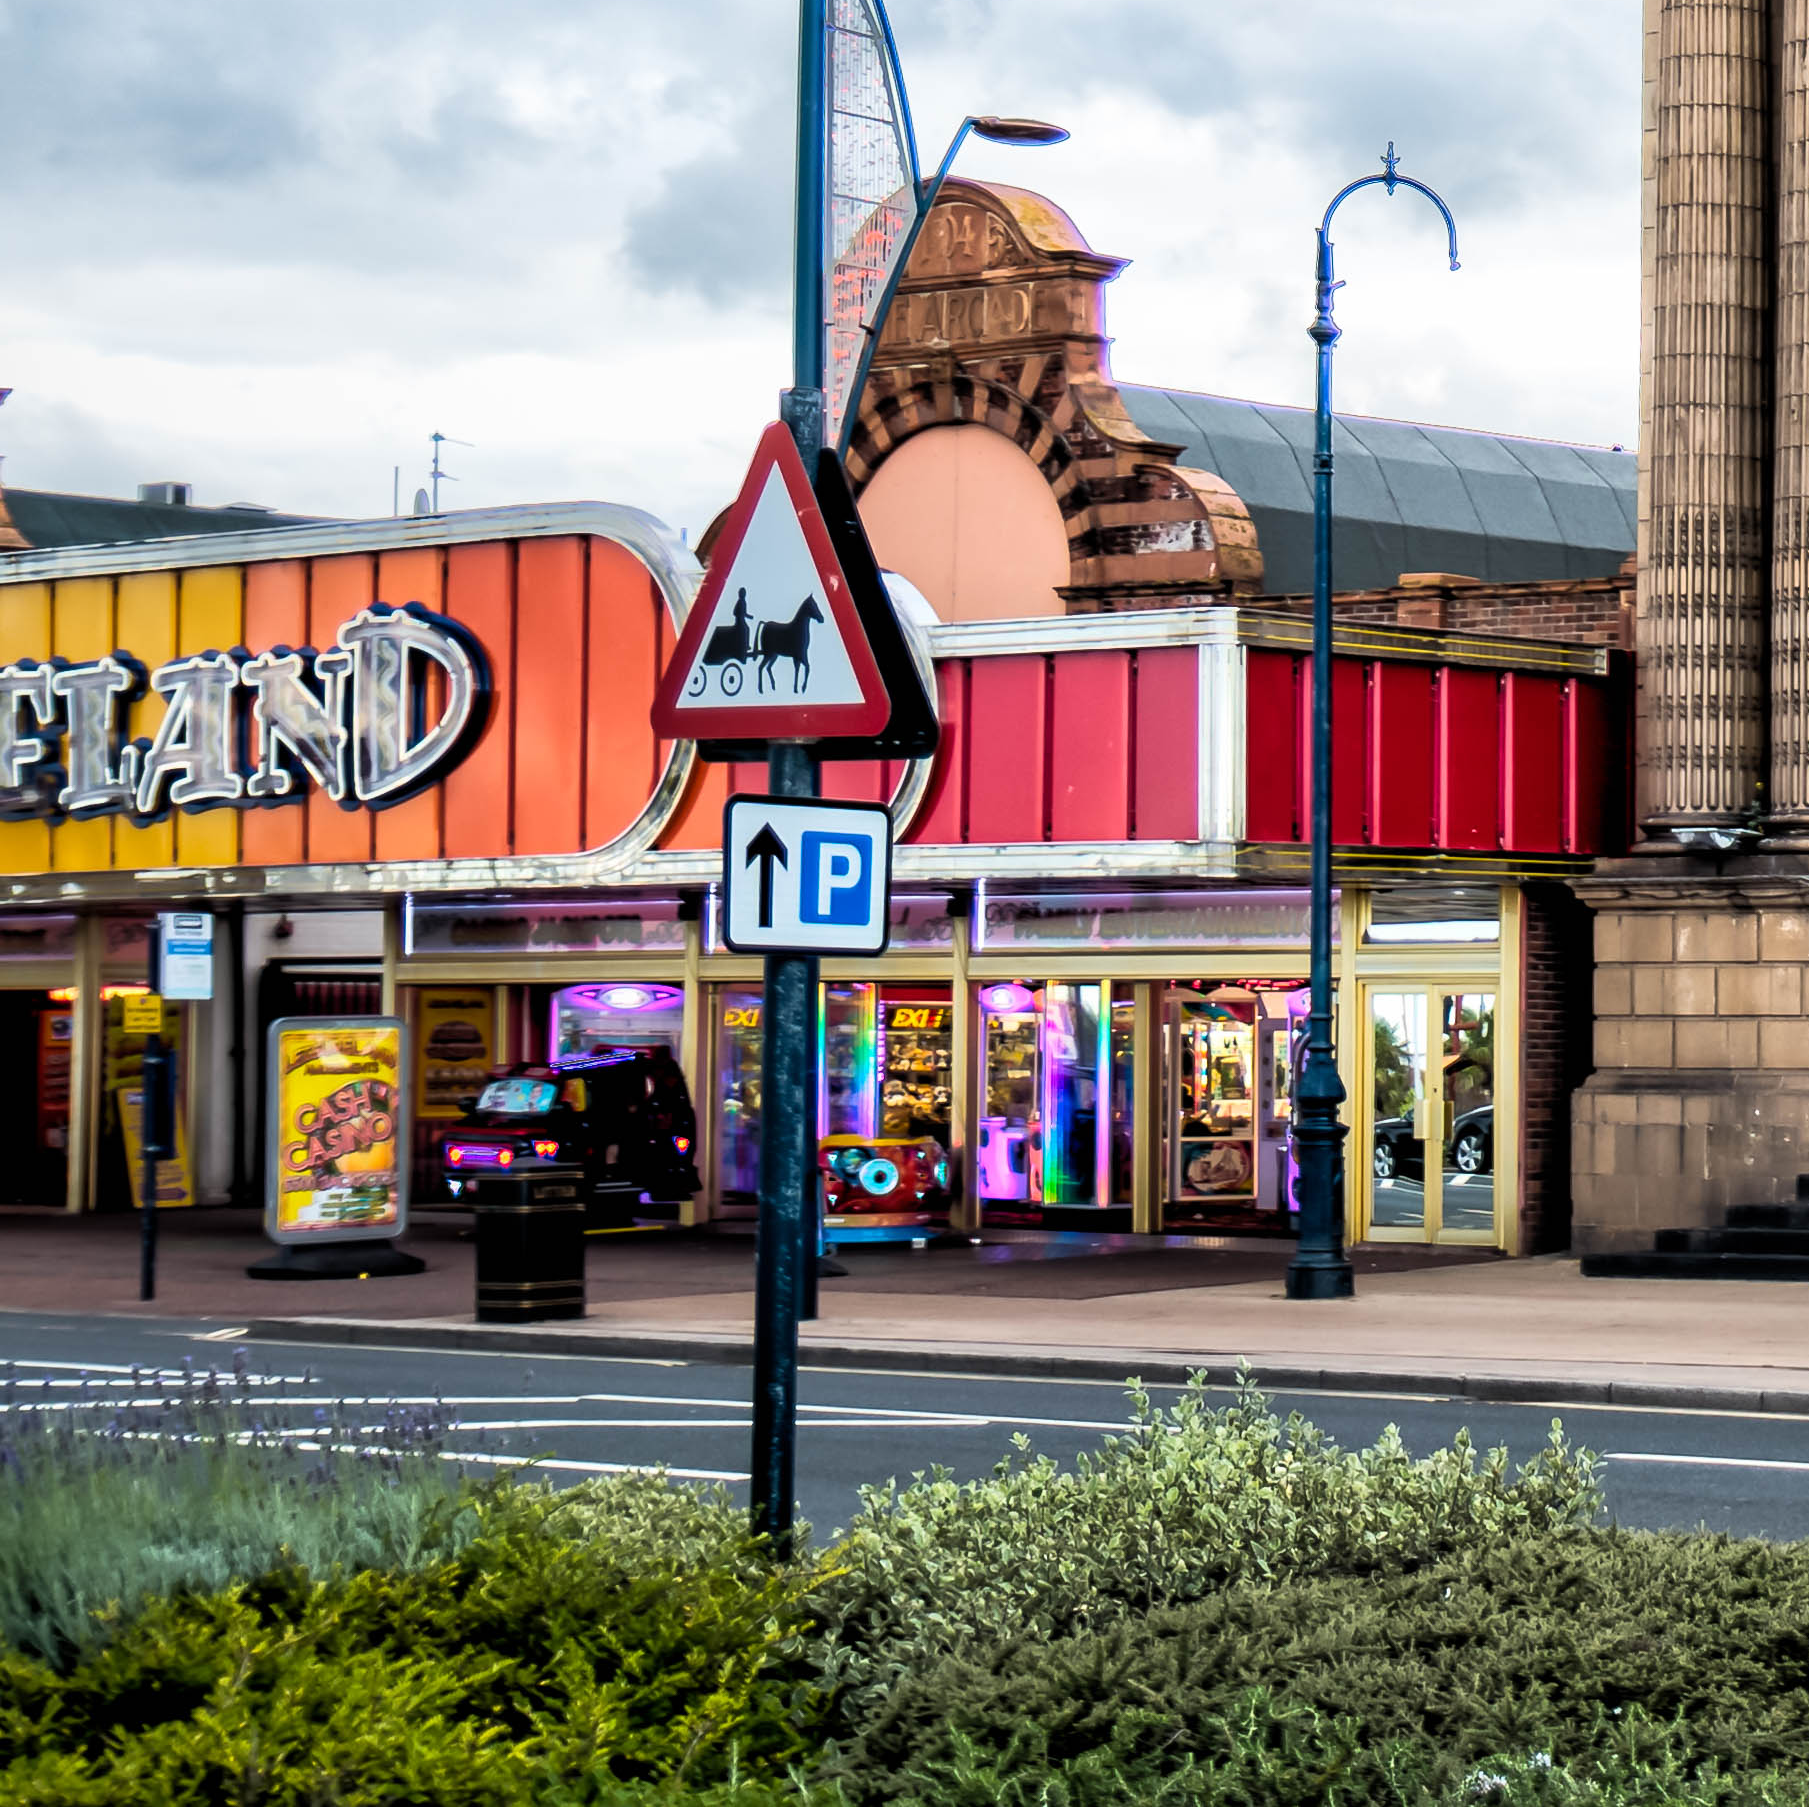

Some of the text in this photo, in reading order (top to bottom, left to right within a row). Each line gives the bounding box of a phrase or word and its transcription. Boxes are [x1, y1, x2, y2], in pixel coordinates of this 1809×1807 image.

[818, 842, 862, 916] P
[294, 1080, 373, 1134] CASH
[283, 1111, 393, 1172] CASINO
